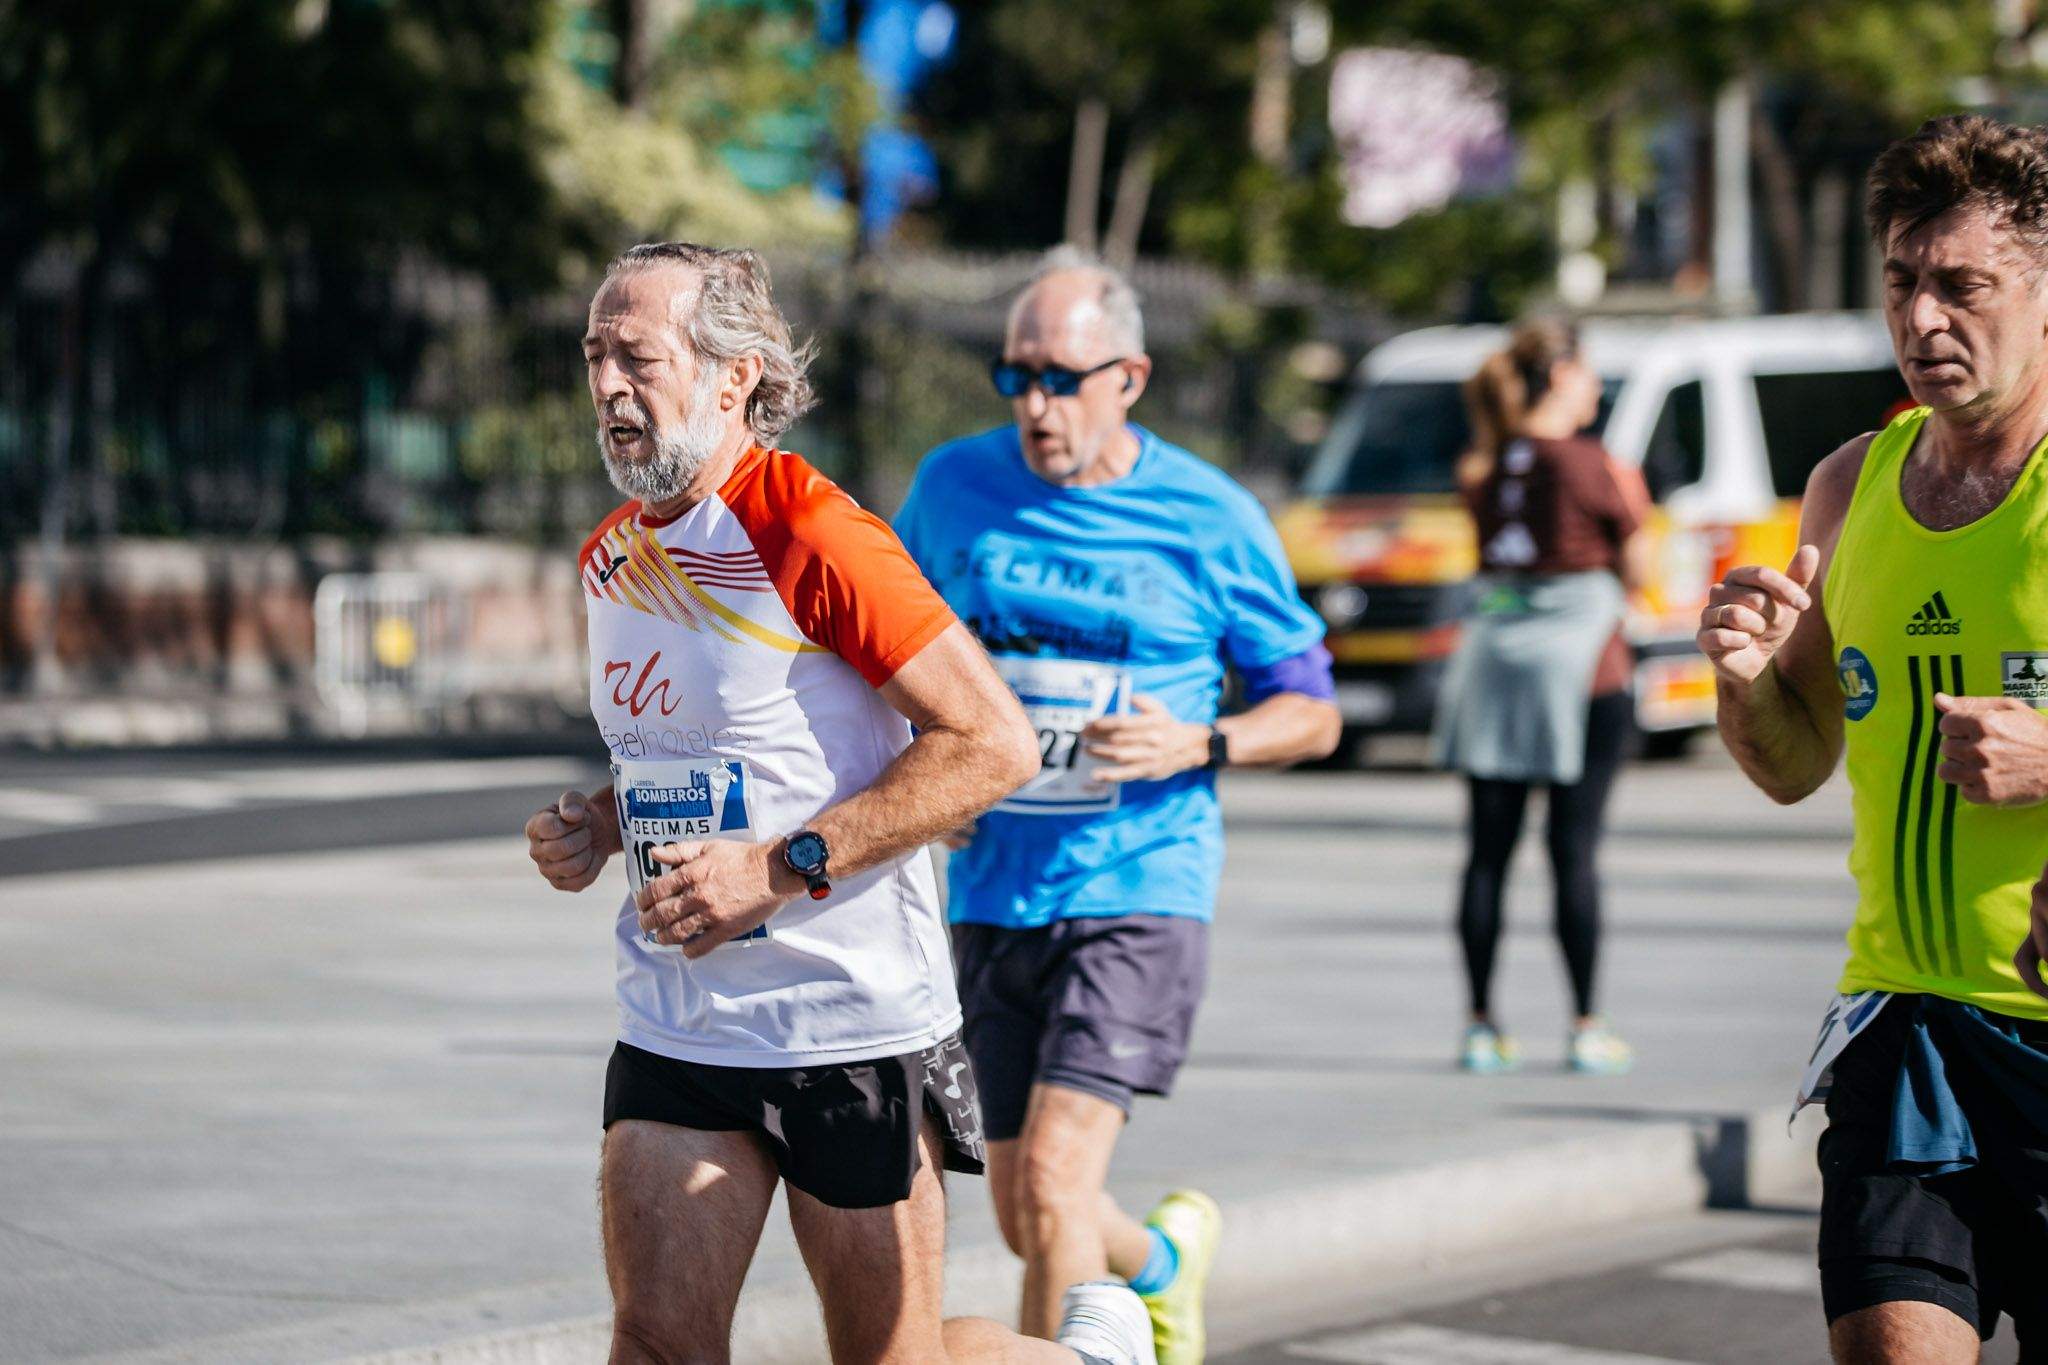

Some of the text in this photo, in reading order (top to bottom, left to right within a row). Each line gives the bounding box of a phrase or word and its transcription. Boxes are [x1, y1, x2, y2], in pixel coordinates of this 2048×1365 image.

[1905, 618, 1961, 636] adidas
[634, 787, 708, 803] BOMBEROS
[671, 800, 710, 818] MADRID
[634, 819, 710, 836] DECIMAS
